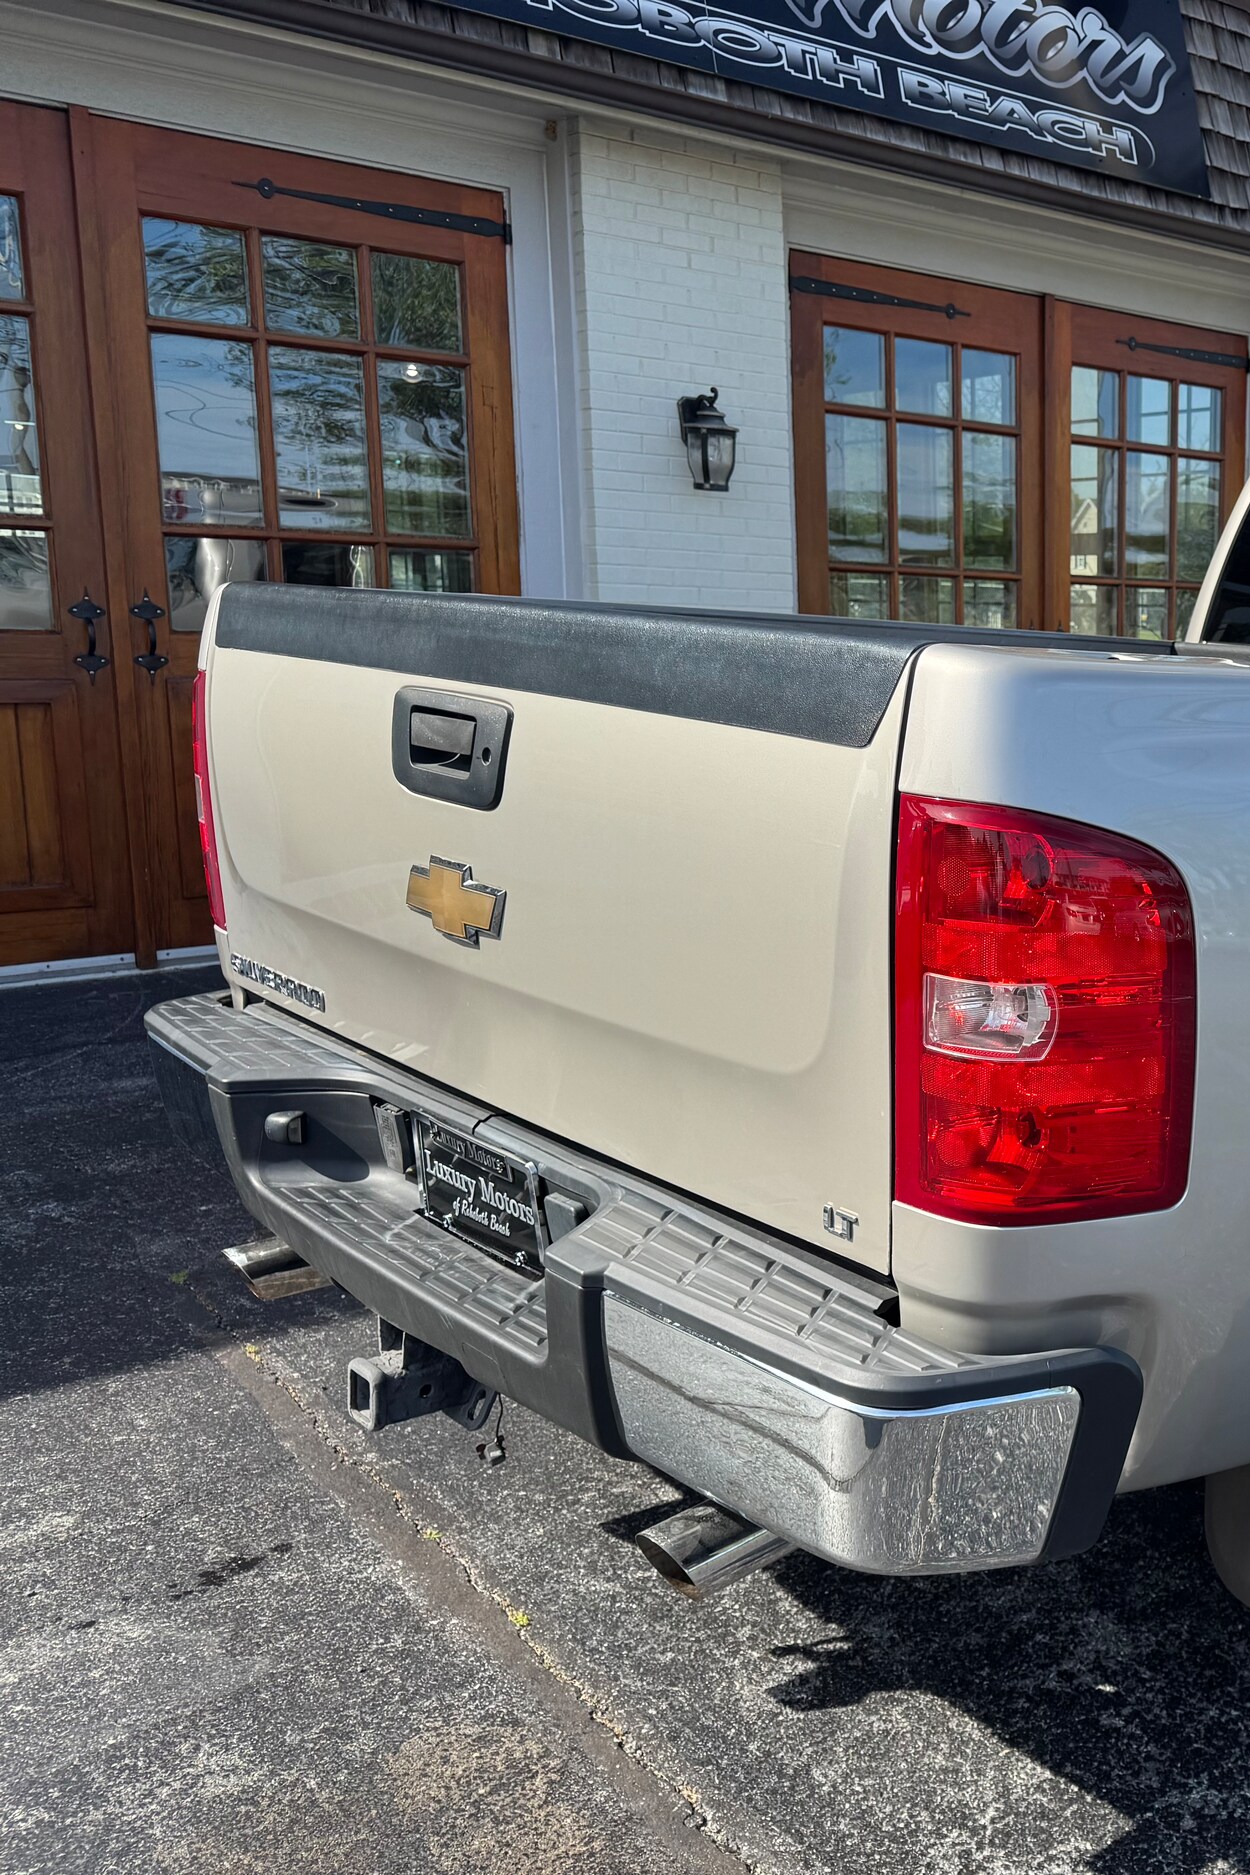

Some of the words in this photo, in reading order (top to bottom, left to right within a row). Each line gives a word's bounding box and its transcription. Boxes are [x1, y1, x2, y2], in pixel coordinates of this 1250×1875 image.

[898, 67, 1138, 165] BEACH
[424, 1149, 476, 1203] Luxury
[478, 1176, 535, 1226] Motors
[453, 1197, 460, 1216] of
[823, 1203, 859, 1242] LT
